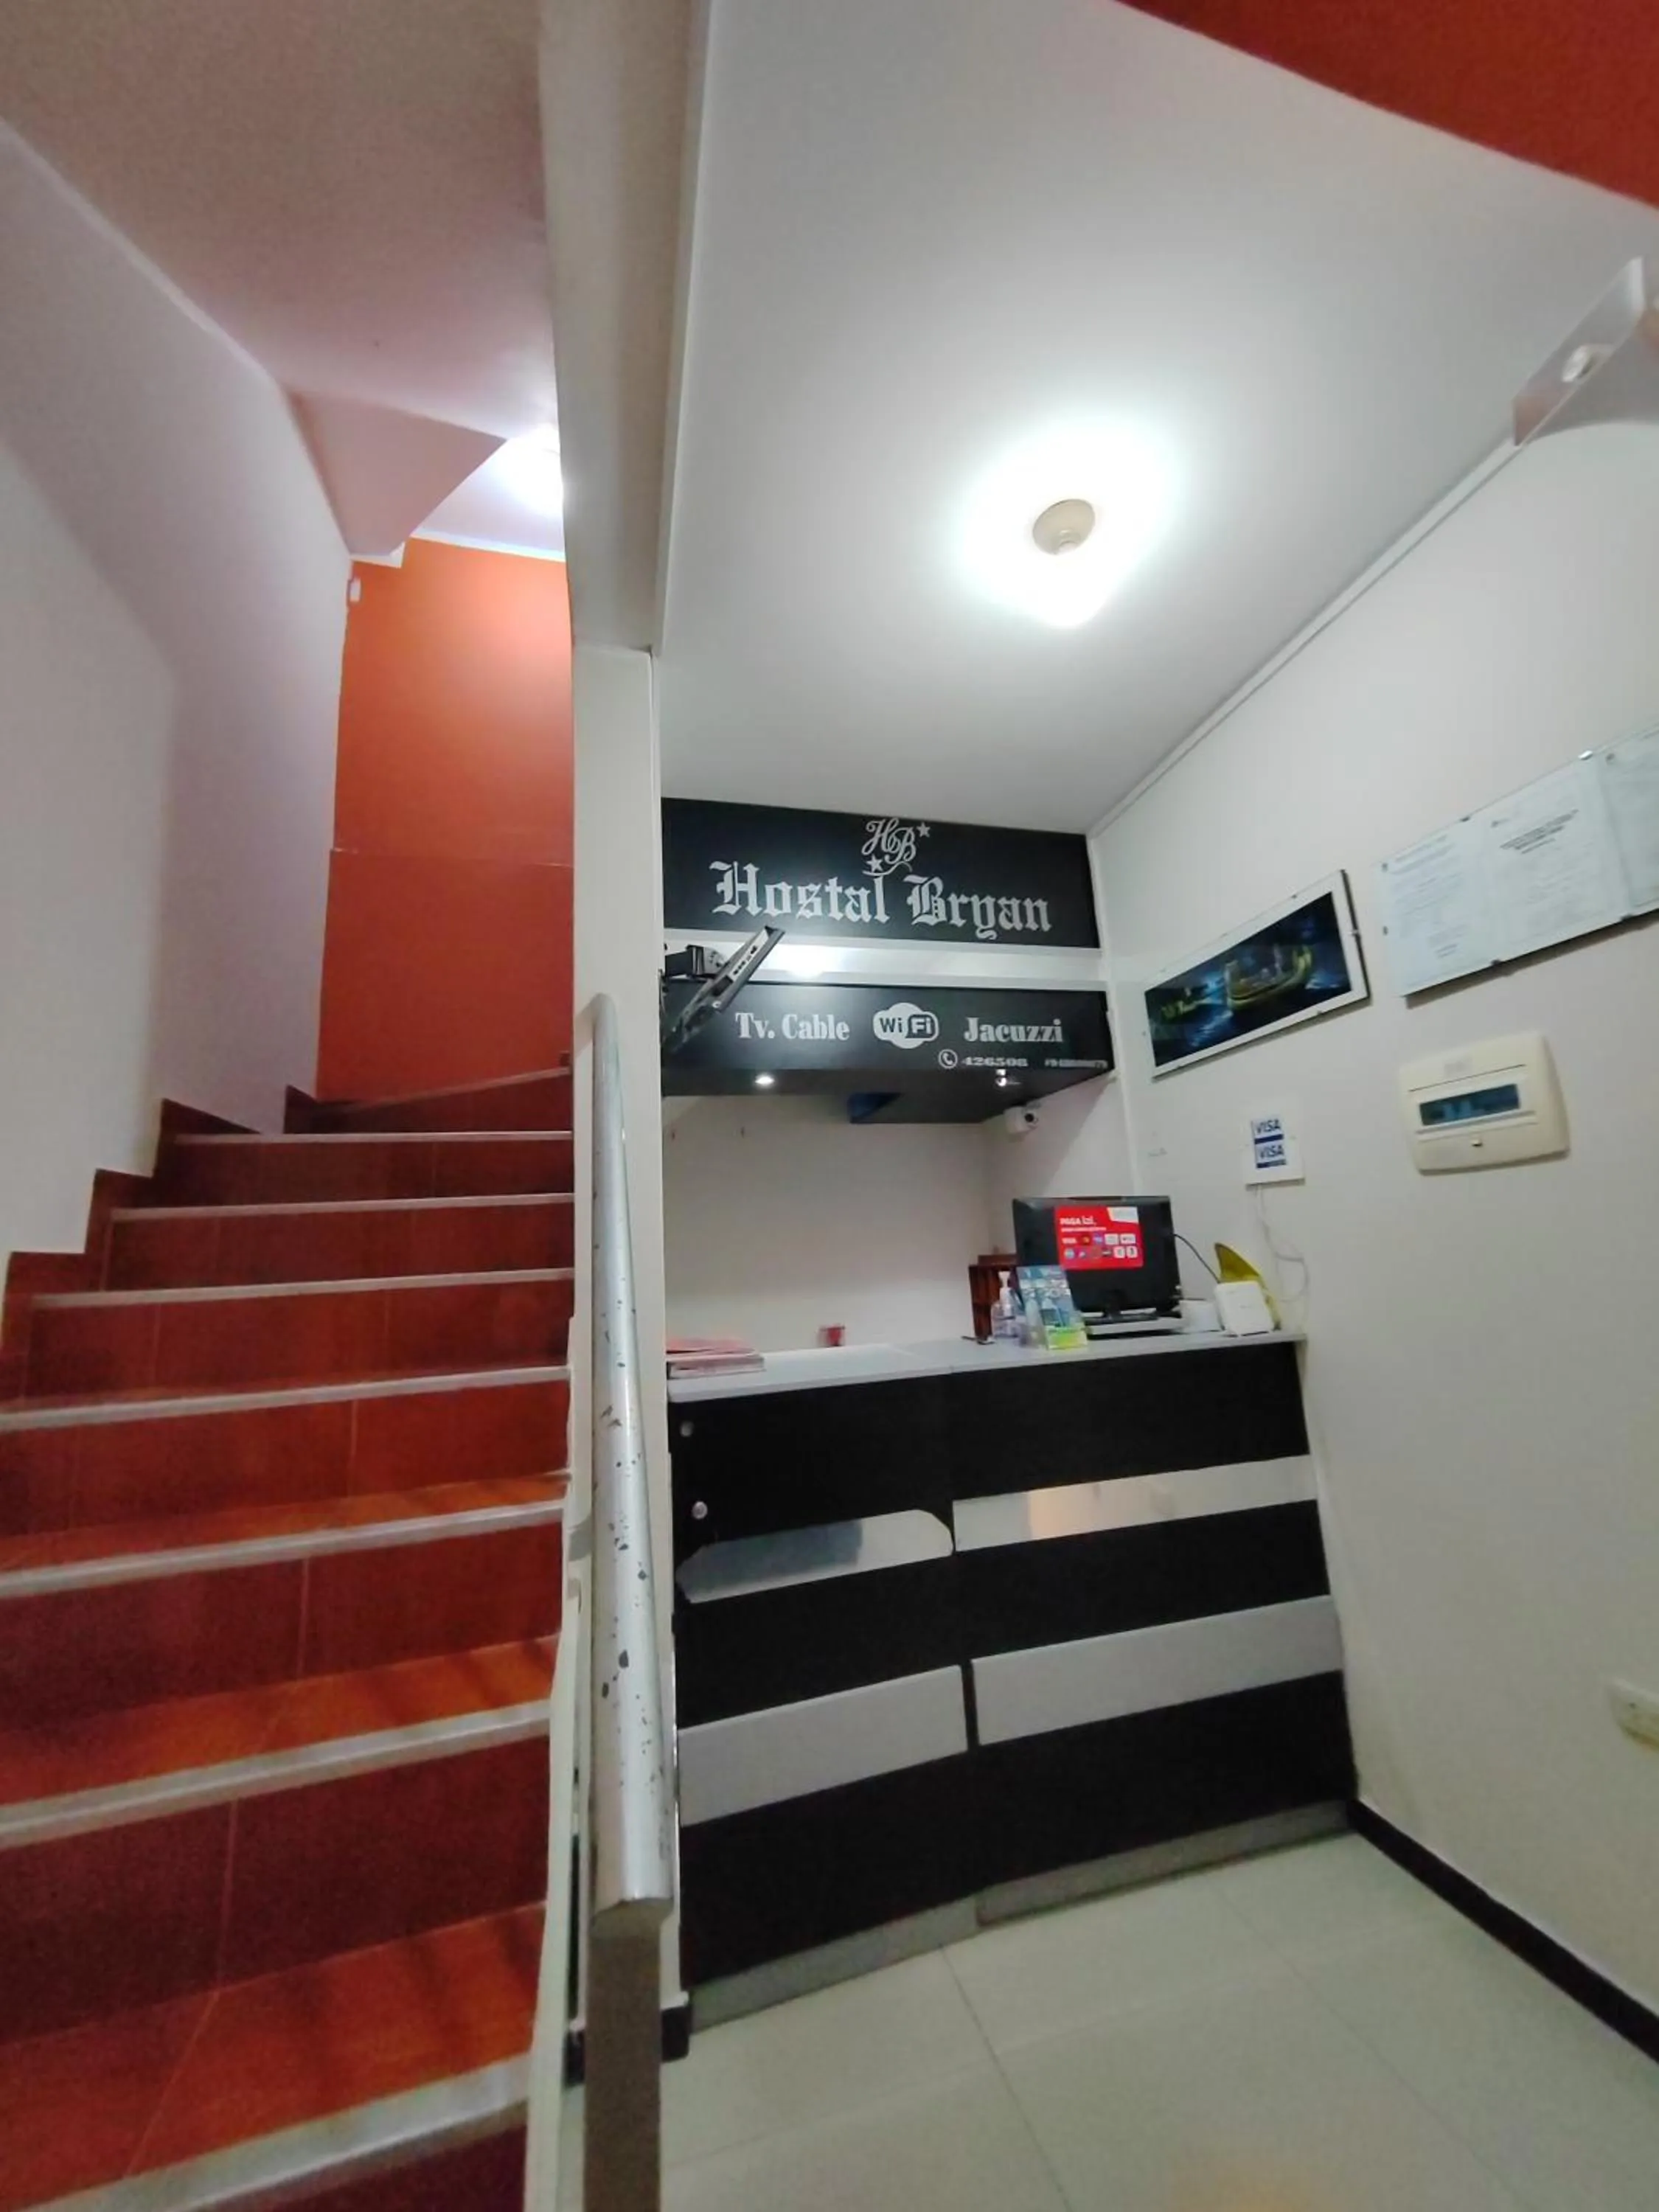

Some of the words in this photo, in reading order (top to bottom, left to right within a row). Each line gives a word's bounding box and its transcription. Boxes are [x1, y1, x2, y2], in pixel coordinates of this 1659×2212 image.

[861, 818, 916, 864] HB
[709, 861, 891, 924] Hostal
[902, 874, 1052, 940] Bryan
[735, 1012, 775, 1039] Tv.
[782, 1013, 849, 1040] Cable
[964, 1018, 1063, 1043] Jacuzzi
[1256, 1119, 1281, 1134] VISA
[1259, 1145, 1284, 1159] VISA
